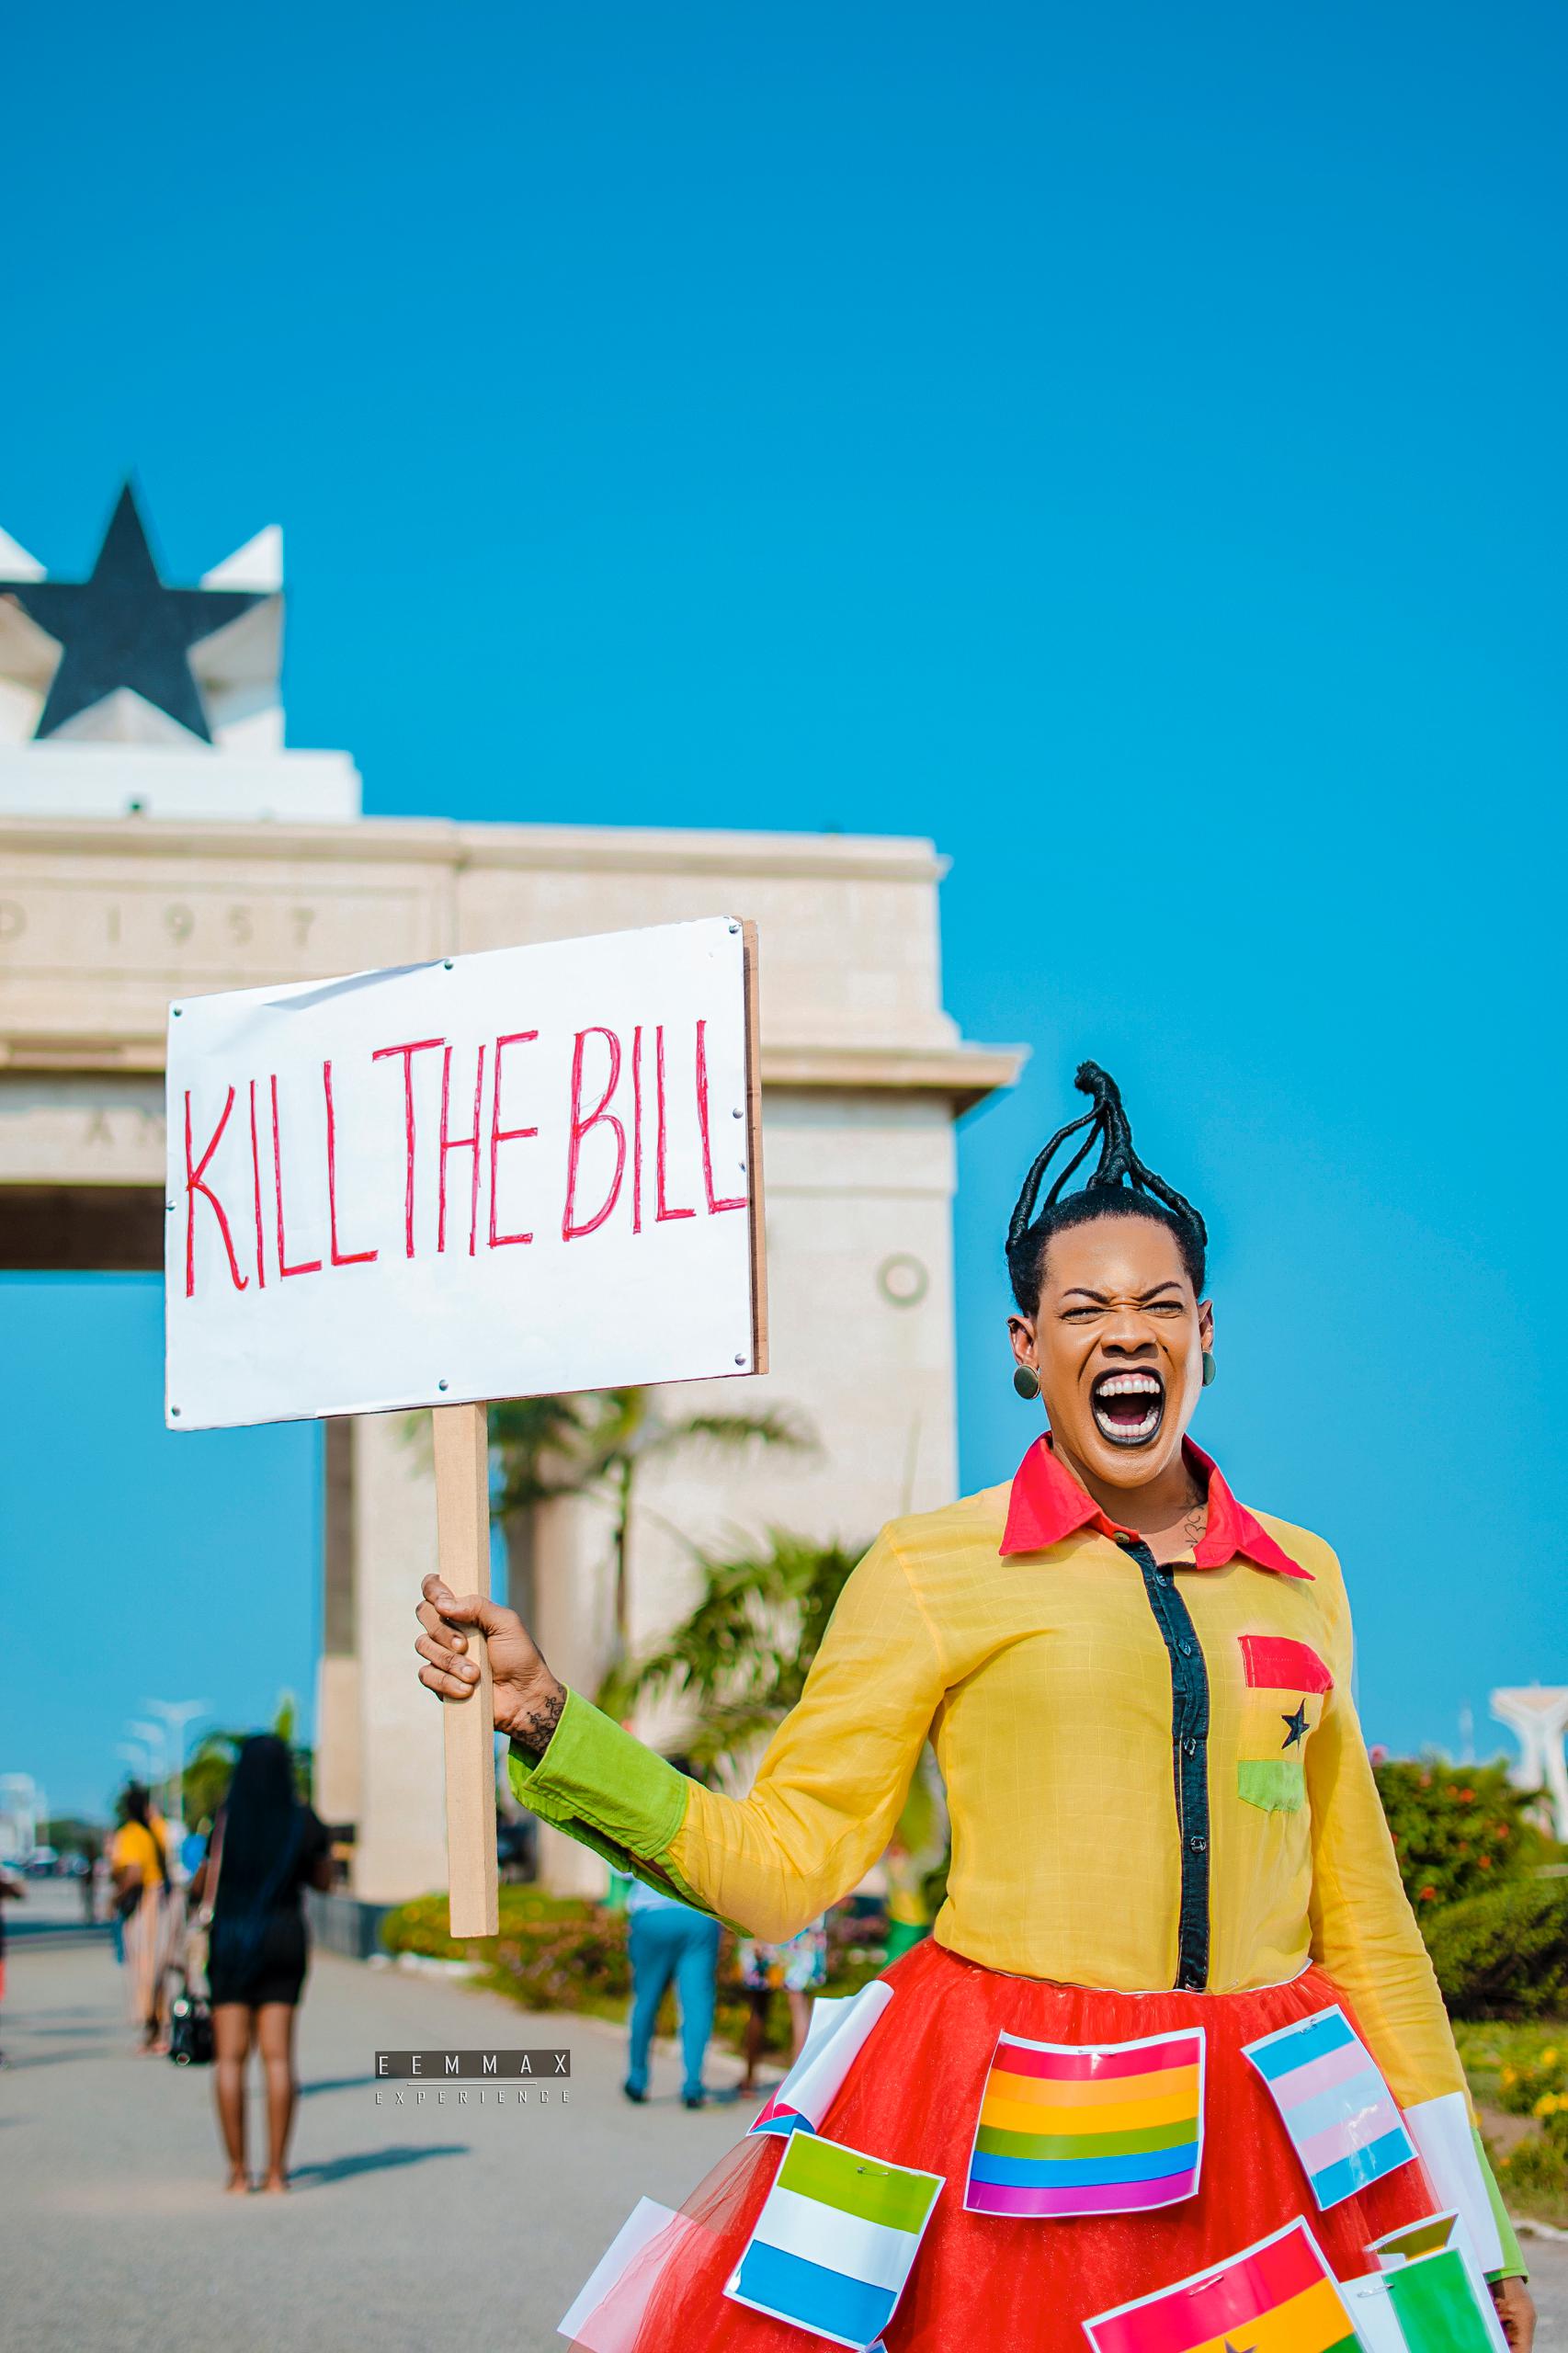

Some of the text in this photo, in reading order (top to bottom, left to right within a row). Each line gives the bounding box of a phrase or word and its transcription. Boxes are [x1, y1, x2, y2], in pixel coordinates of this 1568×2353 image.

[106, 901, 315, 948] 1957
[184, 1019, 748, 1298] KILL THE BILL
